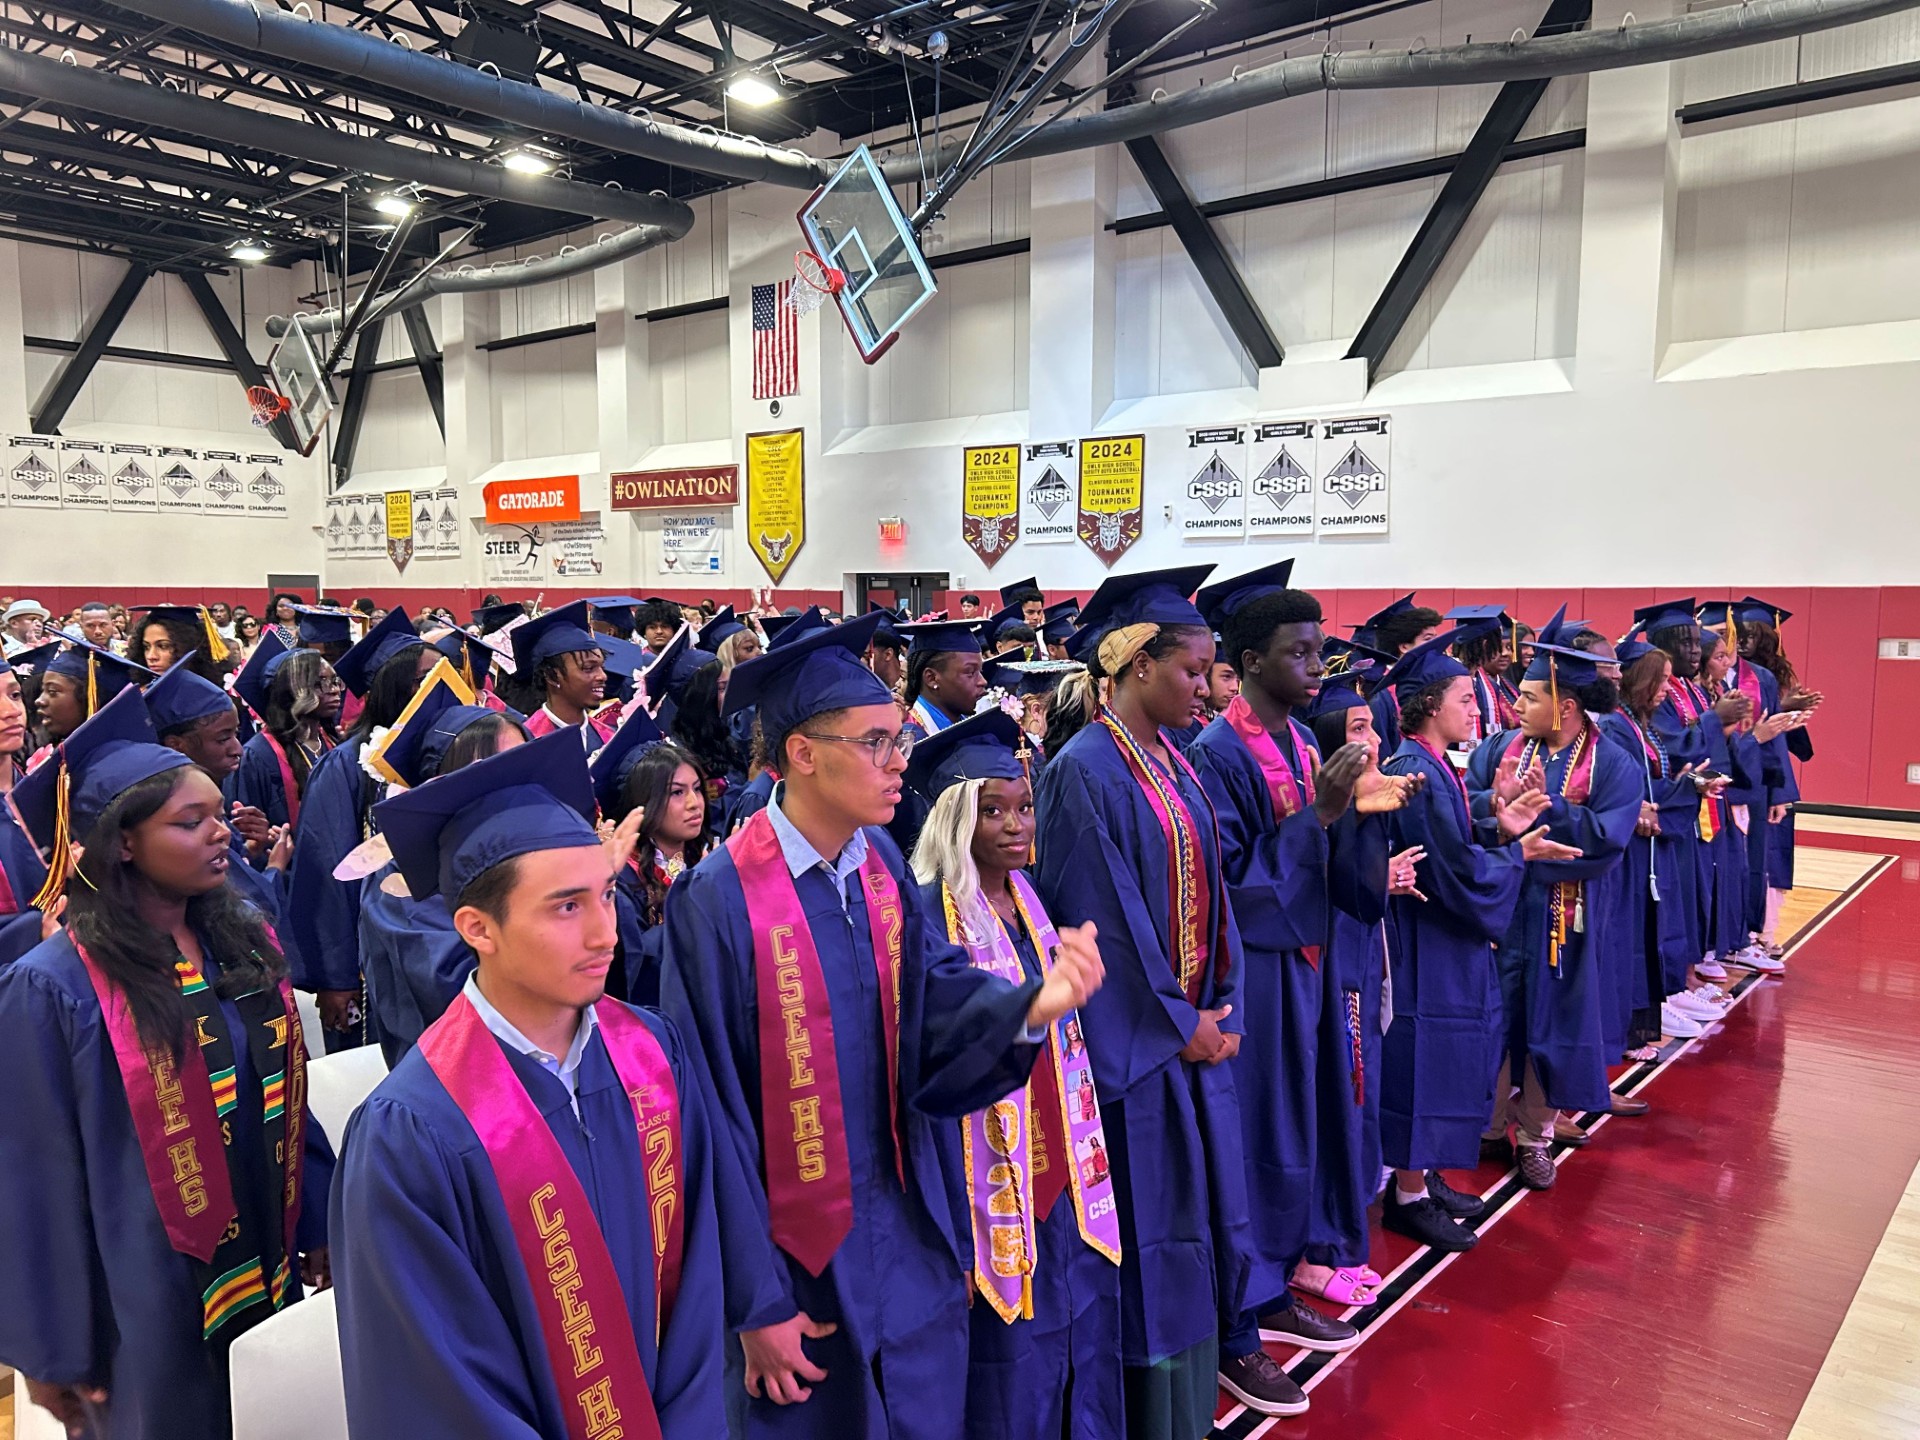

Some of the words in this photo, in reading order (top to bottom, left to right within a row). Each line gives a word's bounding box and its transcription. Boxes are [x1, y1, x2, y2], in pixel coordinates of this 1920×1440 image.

[1091, 442, 1132, 458] 2024
[974, 452, 1009, 466] 2024
[614, 476, 732, 500] #OWLNATION
[1188, 480, 1242, 499] CSSA
[1253, 475, 1312, 495] CSSA
[1323, 472, 1385, 493] CSSA
[12, 494, 60, 502] CHAMPIONS
[970, 494, 1012, 502] TOURNAMENT
[1027, 488, 1073, 504] HVSSA
[1088, 487, 1134, 496] TOURNAMENT
[498, 490, 564, 510] GATORADE
[974, 502, 1008, 510] CHAMPIONS
[1090, 497, 1131, 506] CHAMPIONS
[664, 518, 680, 526] HOW
[680, 518, 694, 526] YOU
[695, 517, 716, 526] MOVE
[1185, 519, 1242, 528] CHAMPIONS
[1250, 516, 1312, 526] CHAMPIONS
[1321, 514, 1386, 526] CHAMPIONS
[664, 528, 670, 536] IS
[672, 528, 686, 536] WHY
[687, 528, 709, 536] WE'RE
[1025, 526, 1073, 534] CHAMPIONS
[485, 540, 520, 554] STEER
[664, 540, 683, 548] HERE.
[768, 924, 816, 1089] CSEE
[636, 1114, 662, 1133] CLASS
[661, 1110, 672, 1124] OF
[788, 1094, 826, 1182] HS
[166, 1136, 208, 1218] HS
[528, 1182, 604, 1379] CSEE
